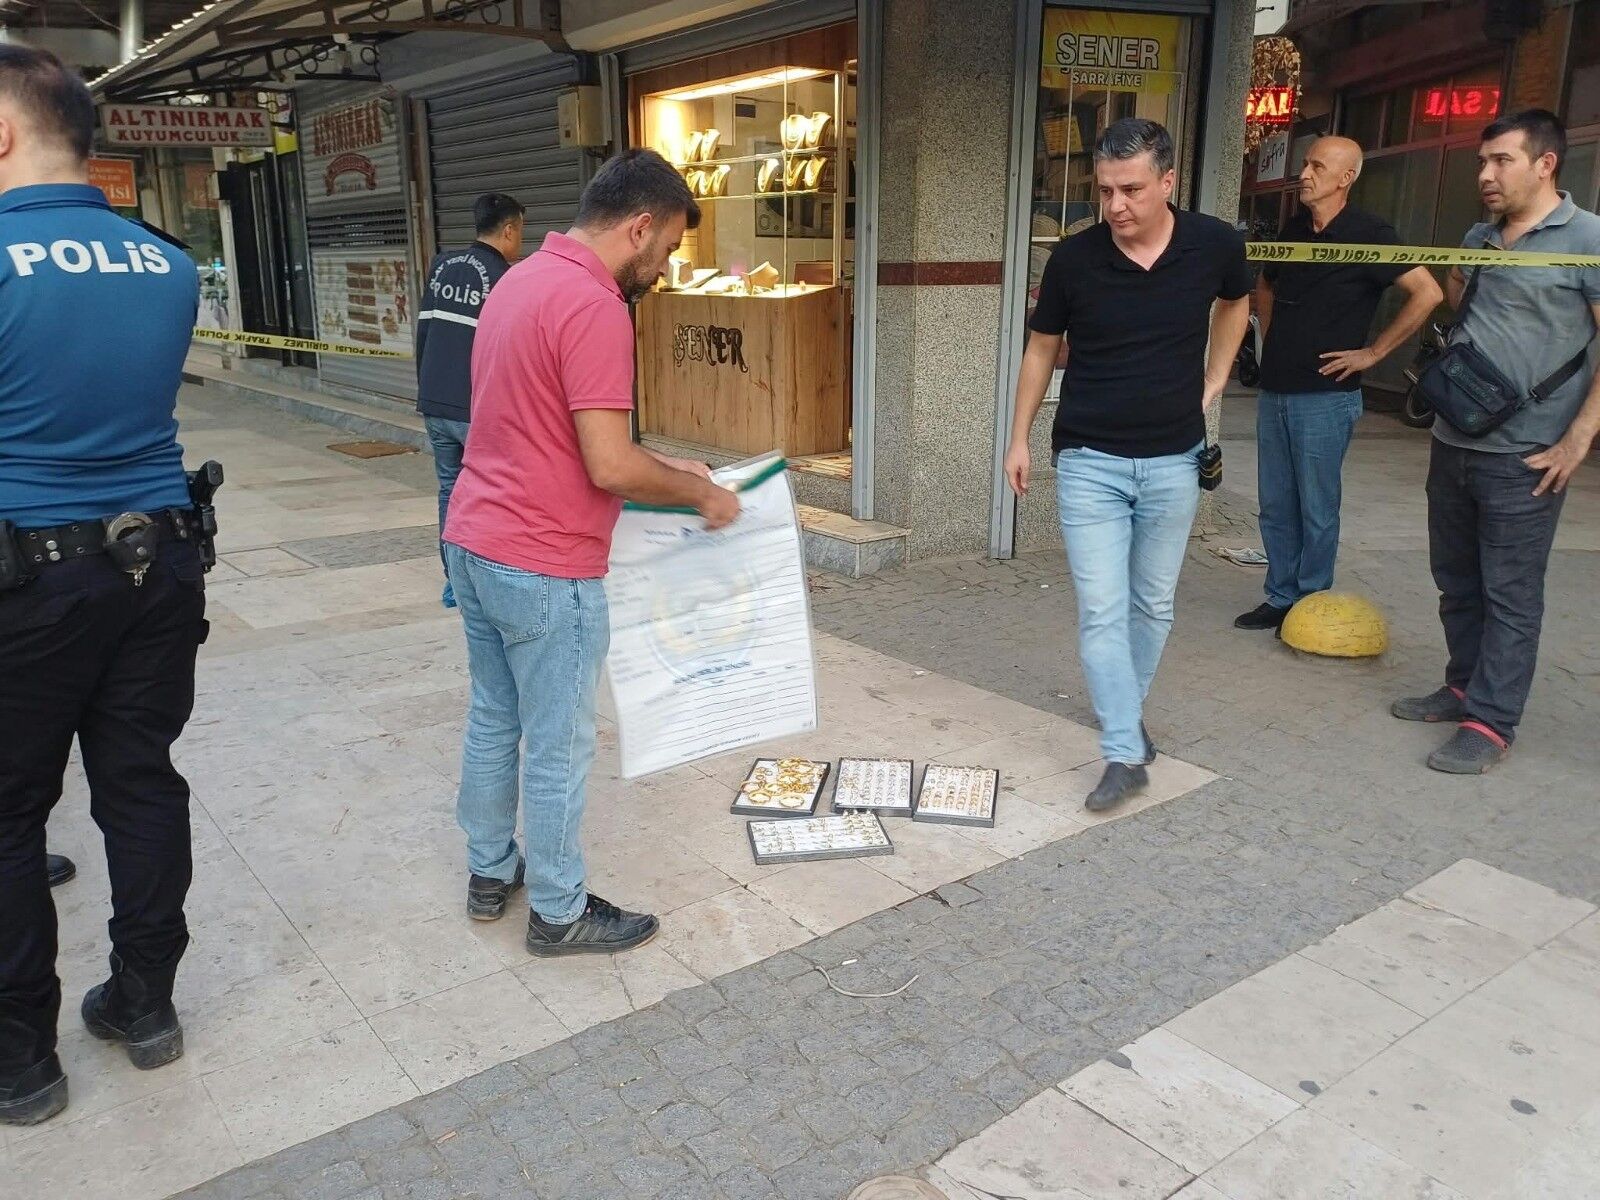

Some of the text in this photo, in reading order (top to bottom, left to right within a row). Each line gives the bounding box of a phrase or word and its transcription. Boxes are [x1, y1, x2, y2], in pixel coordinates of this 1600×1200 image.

[109, 109, 264, 128] ALTINIRMAK
[117, 129, 241, 142] KUYUMCULUK
[6, 239, 171, 277] POLİS
[433, 282, 480, 306] POLİS
